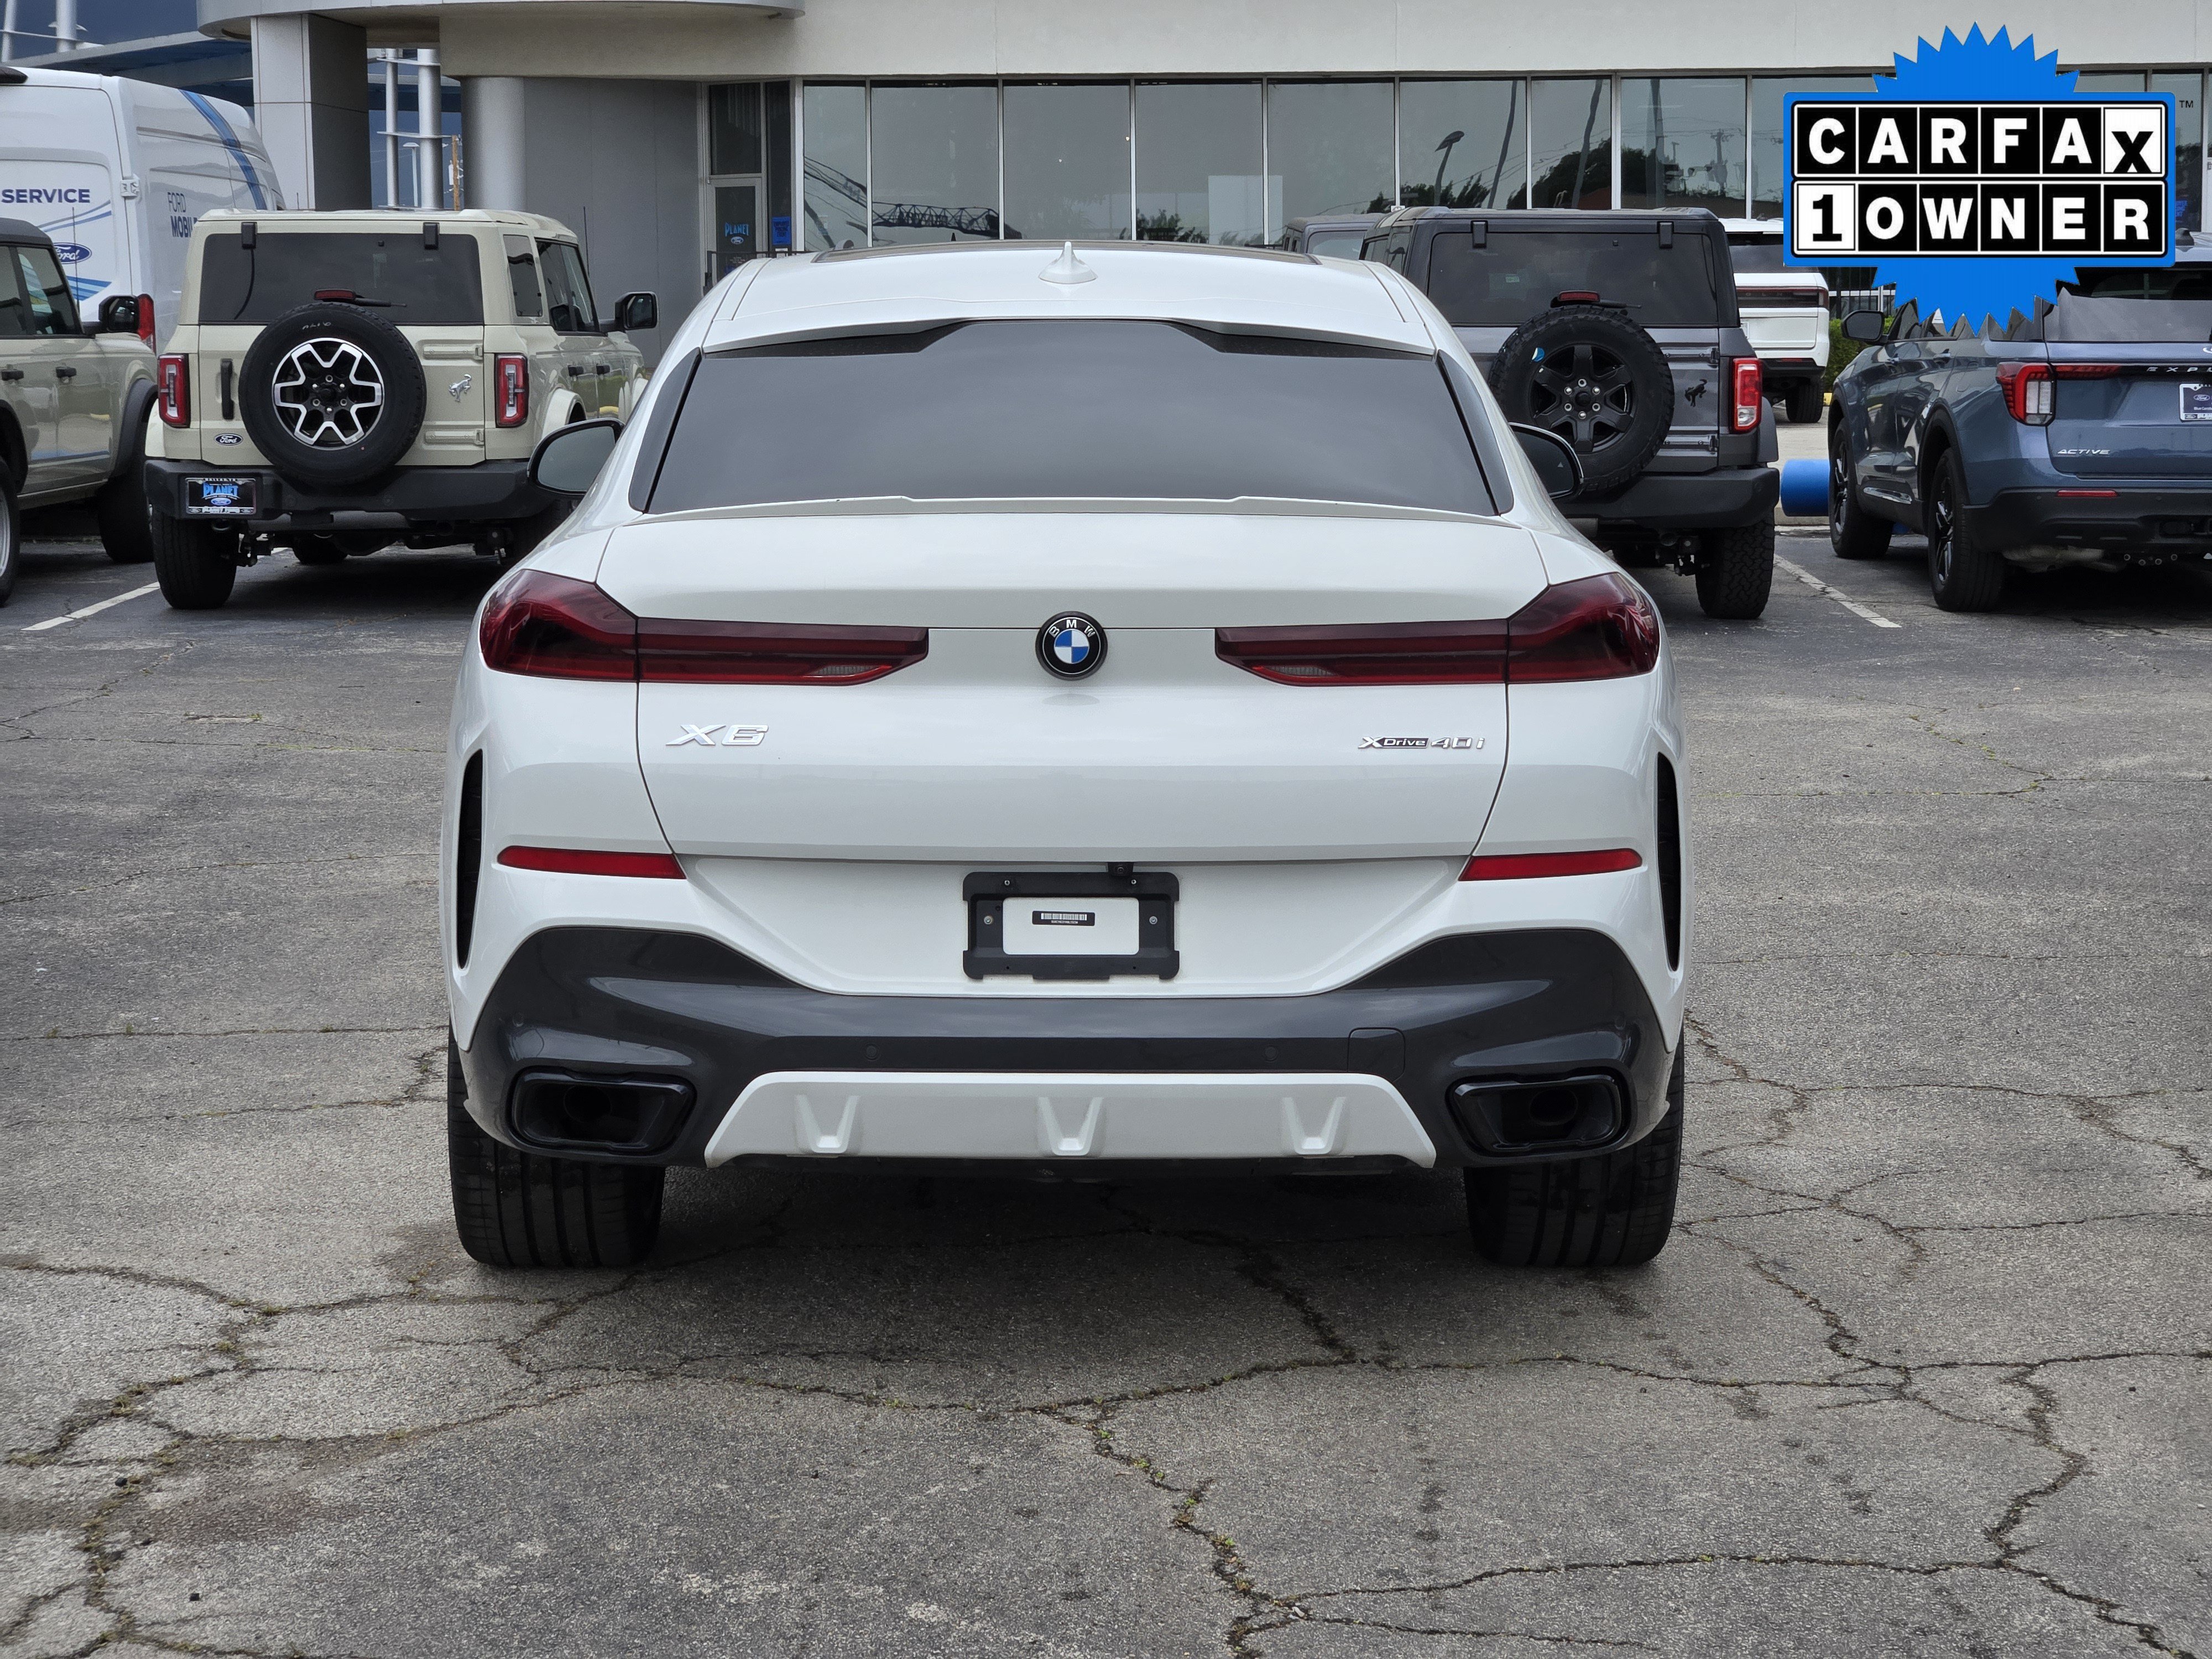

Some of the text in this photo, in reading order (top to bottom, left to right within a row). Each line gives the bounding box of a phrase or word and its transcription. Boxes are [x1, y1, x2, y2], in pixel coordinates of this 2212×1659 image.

[1, 189, 91, 204] SERVICE
[167, 191, 186, 213] FORD
[170, 215, 198, 238] MOBI
[724, 222, 749, 237] PLANET
[56, 246, 80, 260] ord
[219, 435, 238, 443] Ford
[203, 482, 238, 497] PLANET
[1048, 619, 1095, 638] BMW
[665, 724, 769, 746] X6
